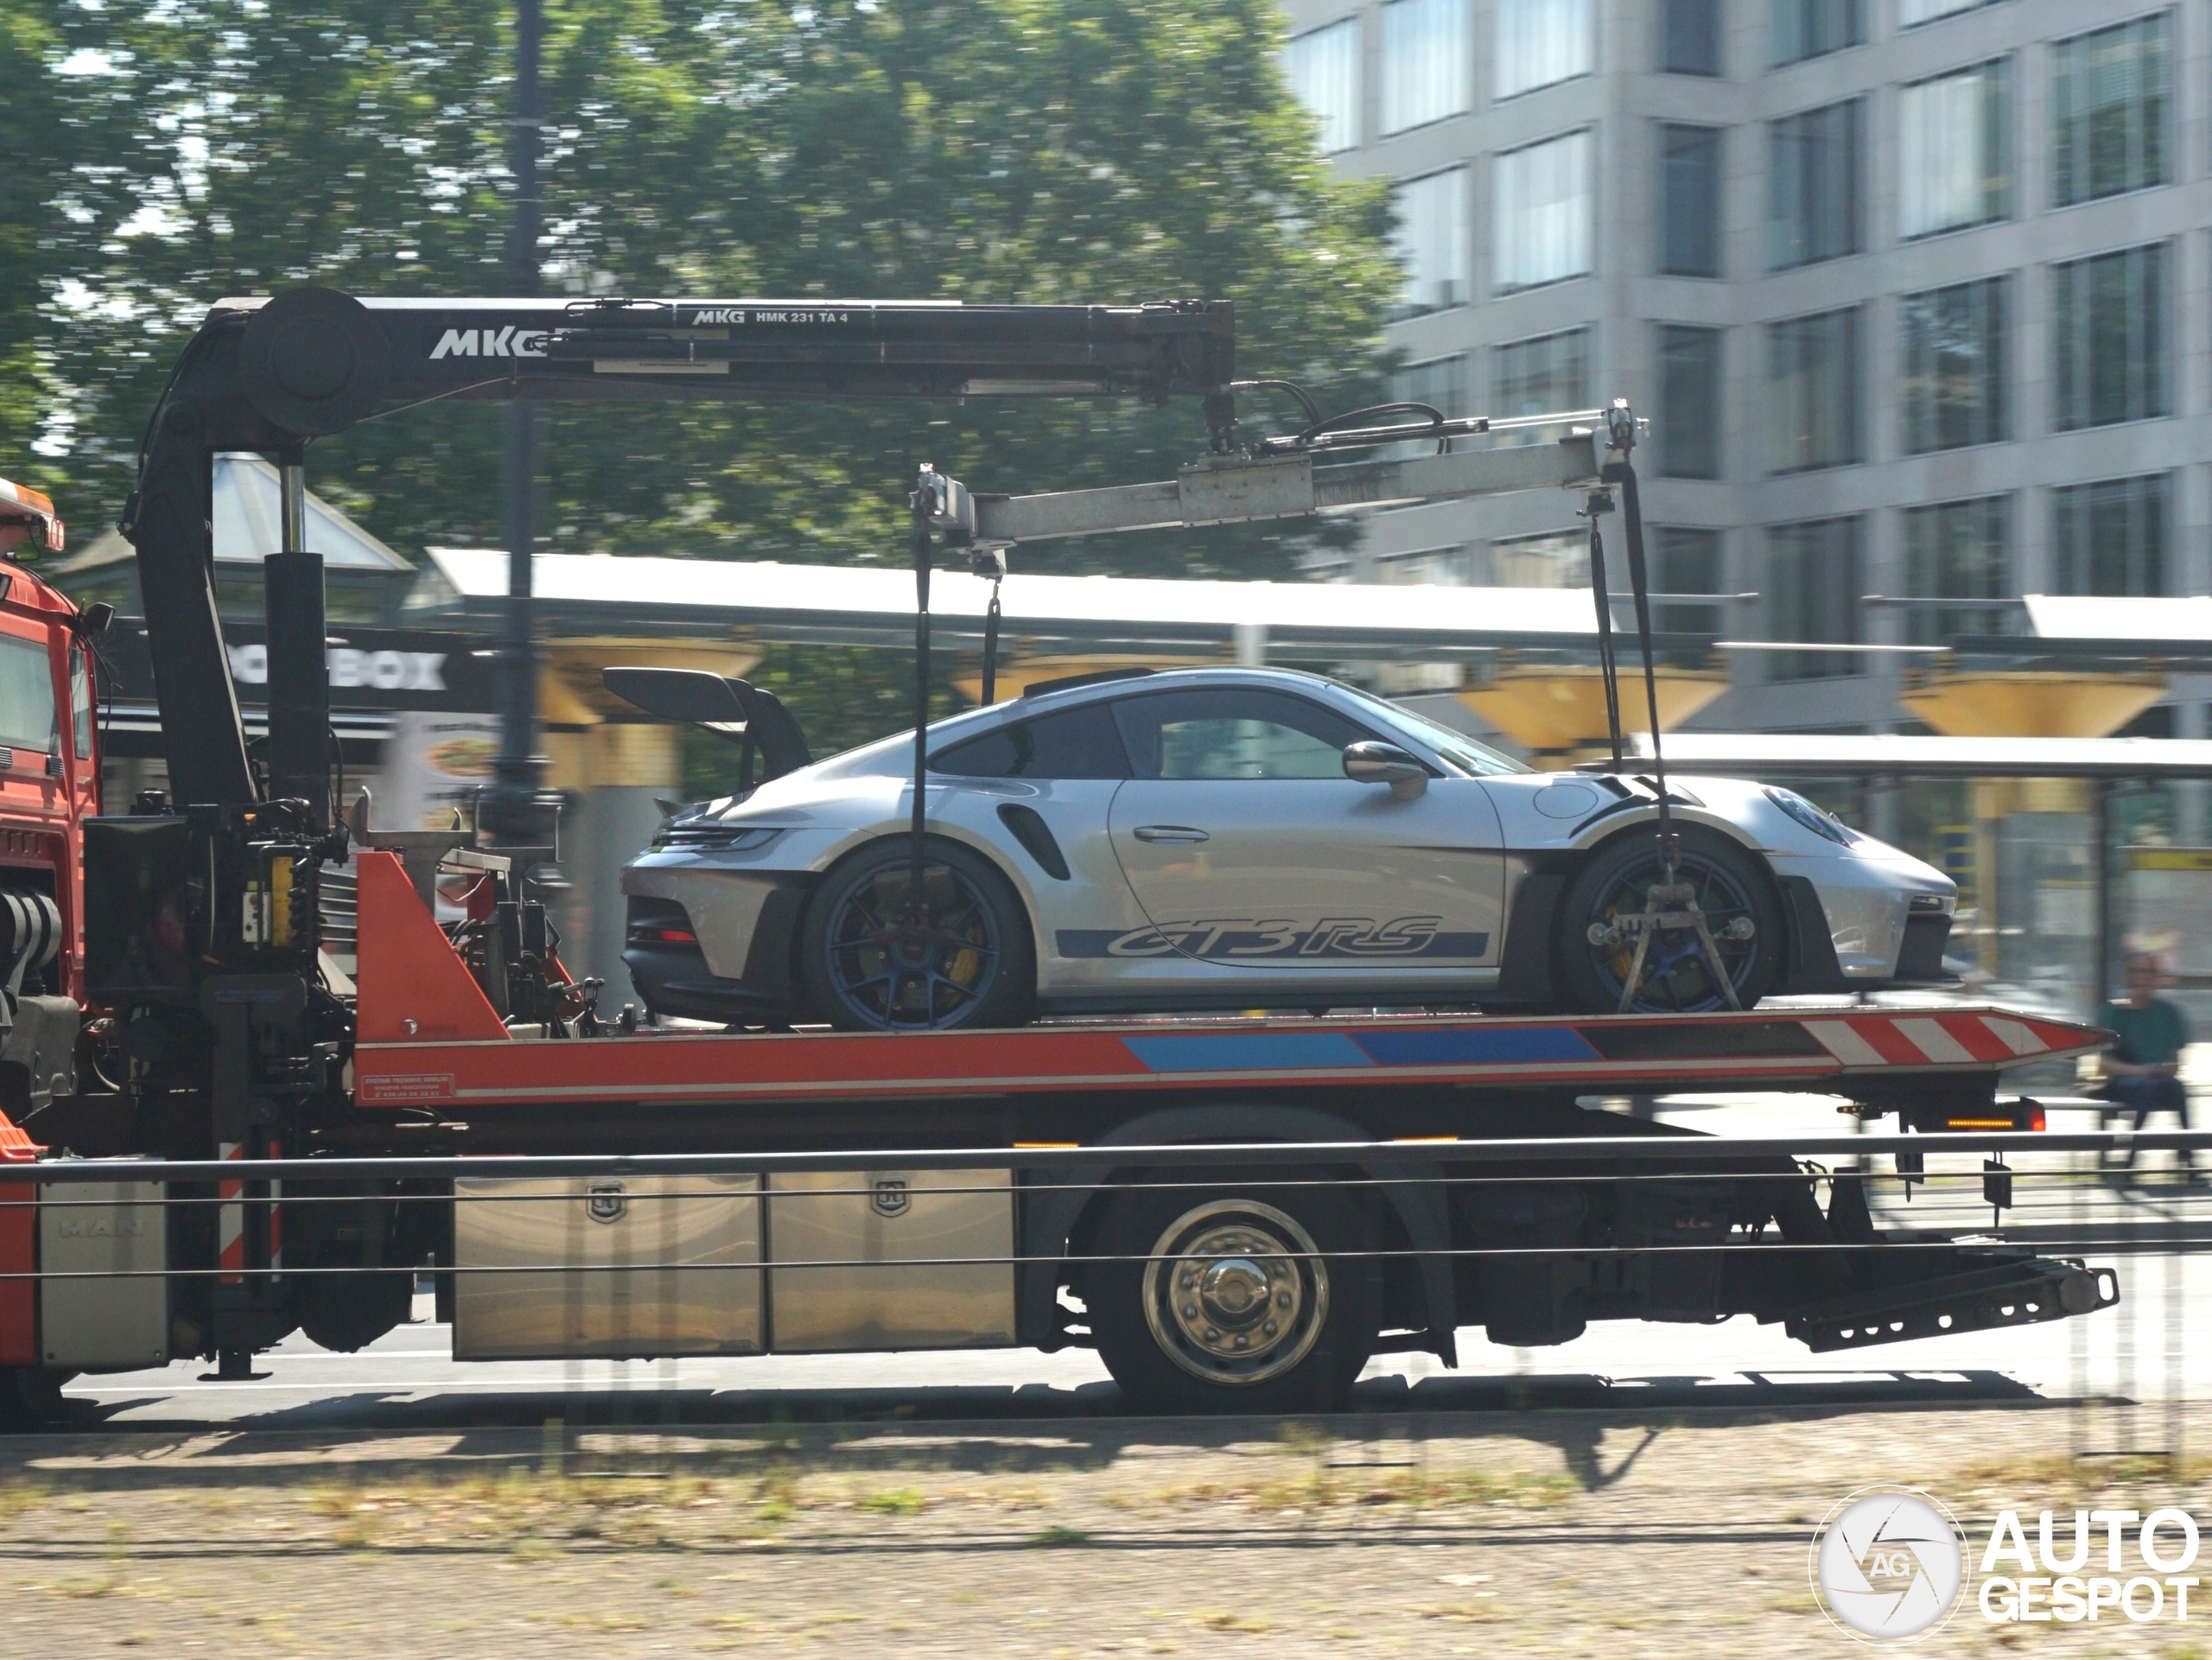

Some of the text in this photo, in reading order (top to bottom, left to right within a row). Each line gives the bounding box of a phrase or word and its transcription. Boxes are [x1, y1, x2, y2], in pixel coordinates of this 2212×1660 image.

[692, 308, 849, 326] MKG HMK 231 TA 4
